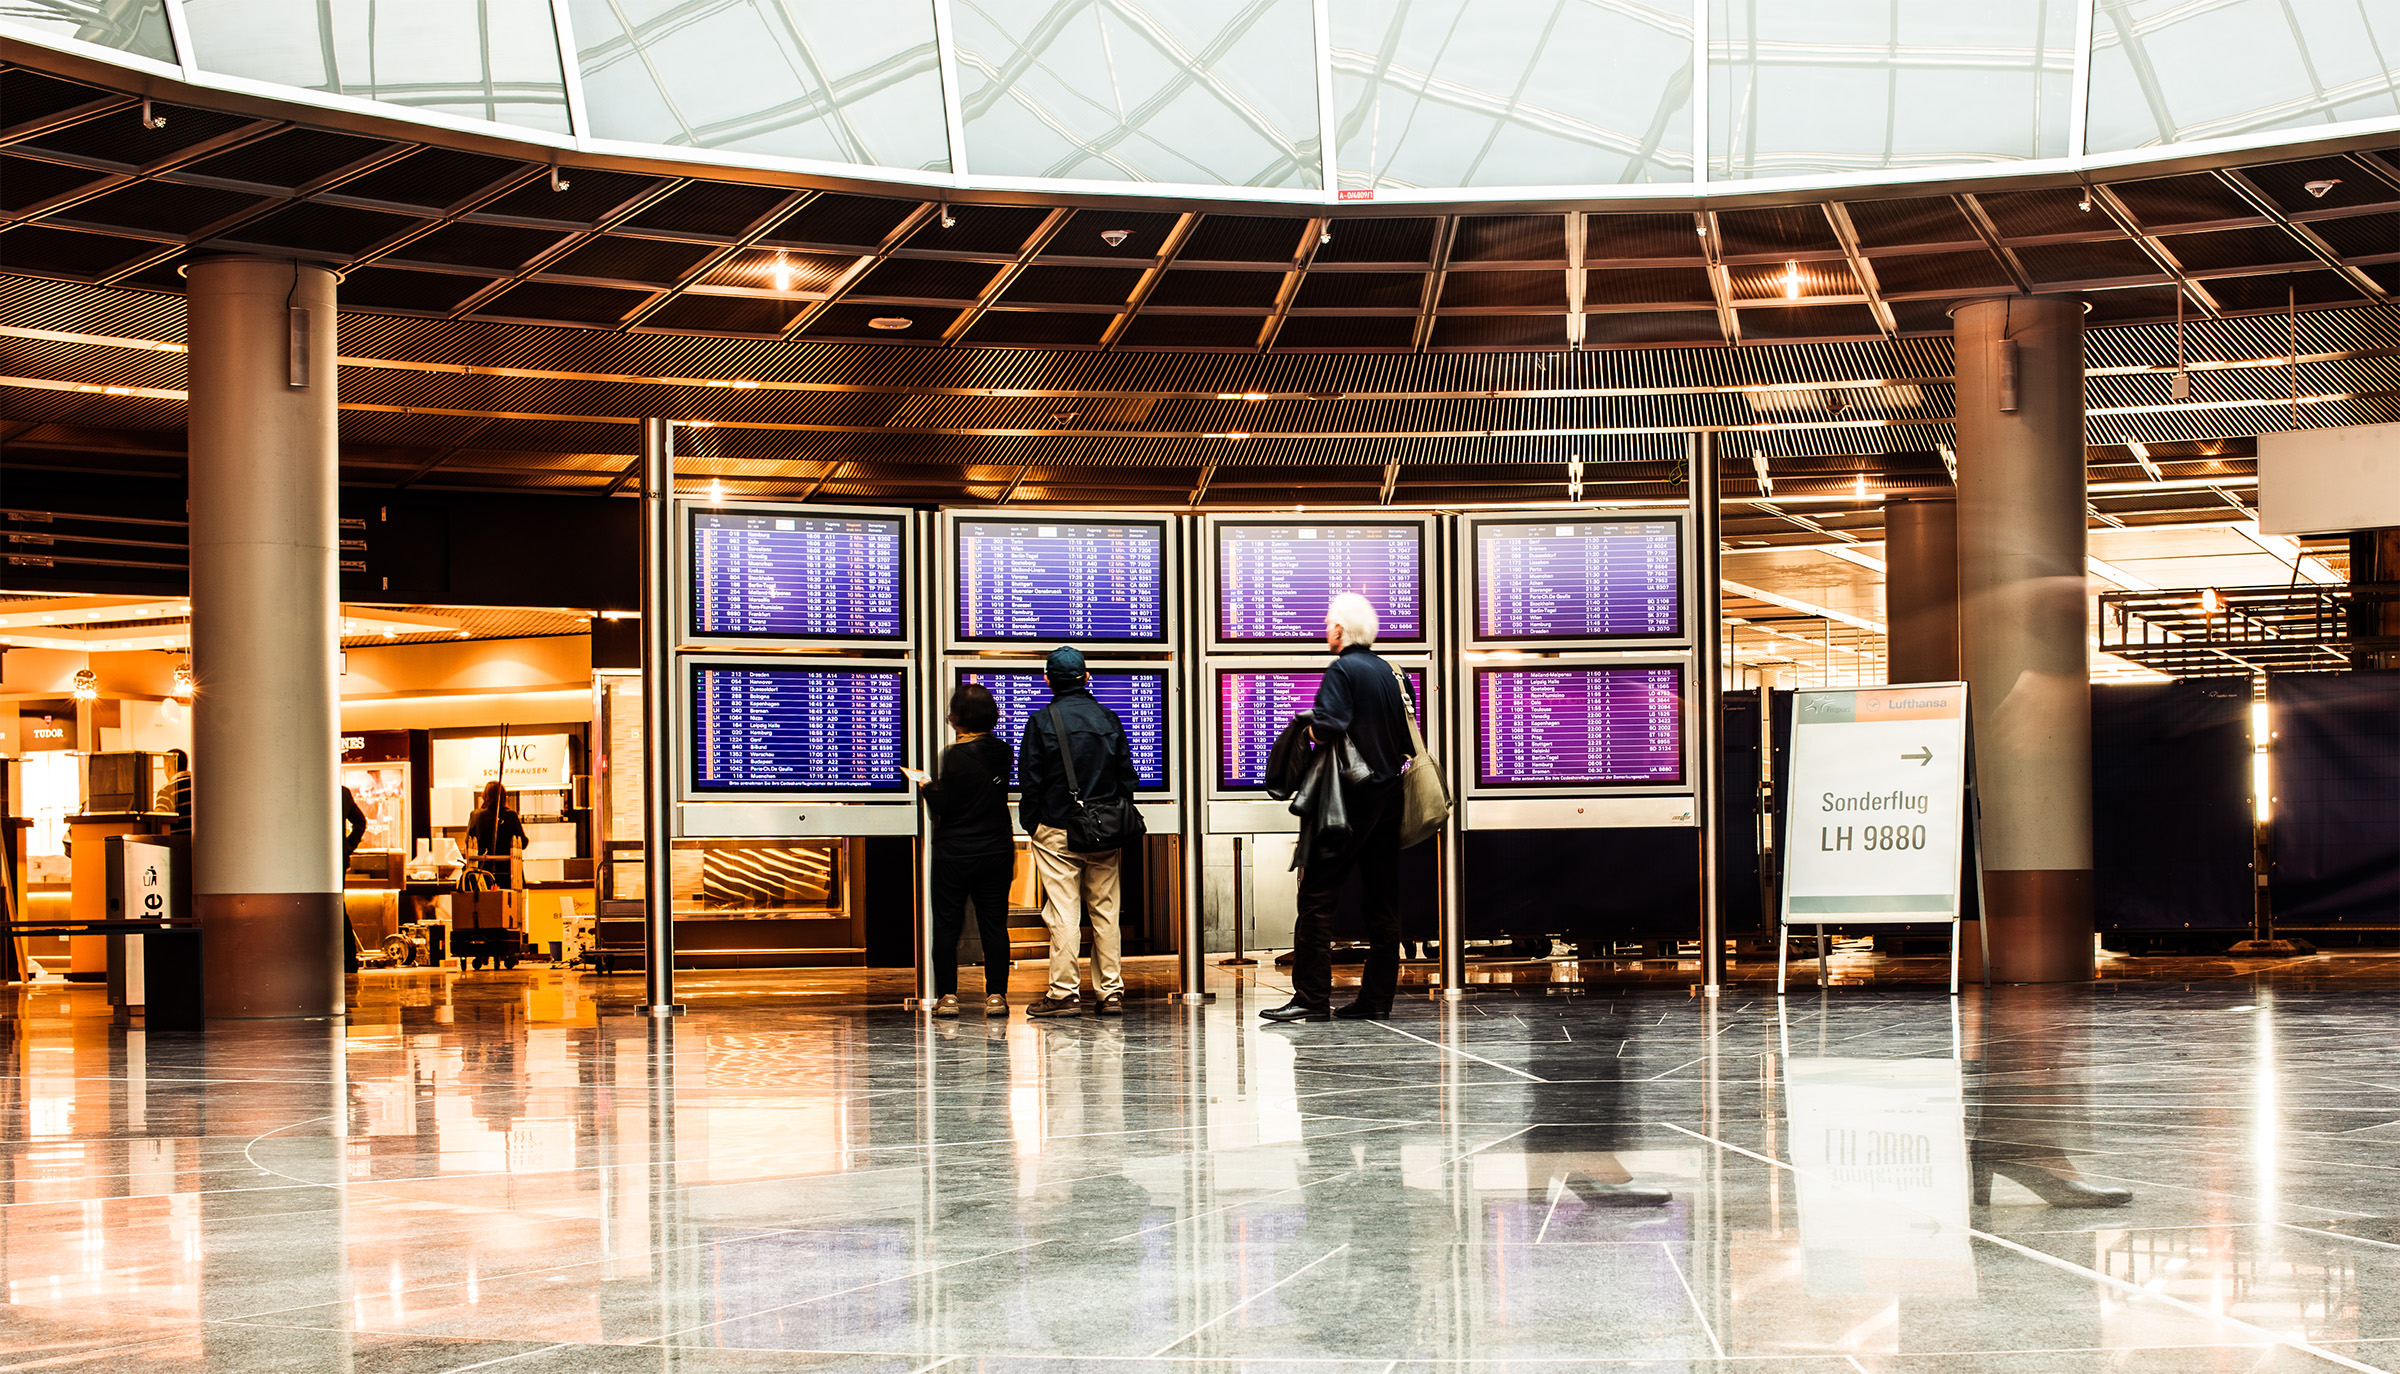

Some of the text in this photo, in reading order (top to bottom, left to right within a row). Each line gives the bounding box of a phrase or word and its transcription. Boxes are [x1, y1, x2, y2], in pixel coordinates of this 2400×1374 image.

[1889, 698, 1946, 709] Lufthansa
[34, 729, 63, 738] TUDOR
[1822, 791, 1928, 814] Sonderflug
[1822, 825, 1926, 852] LH 9880
